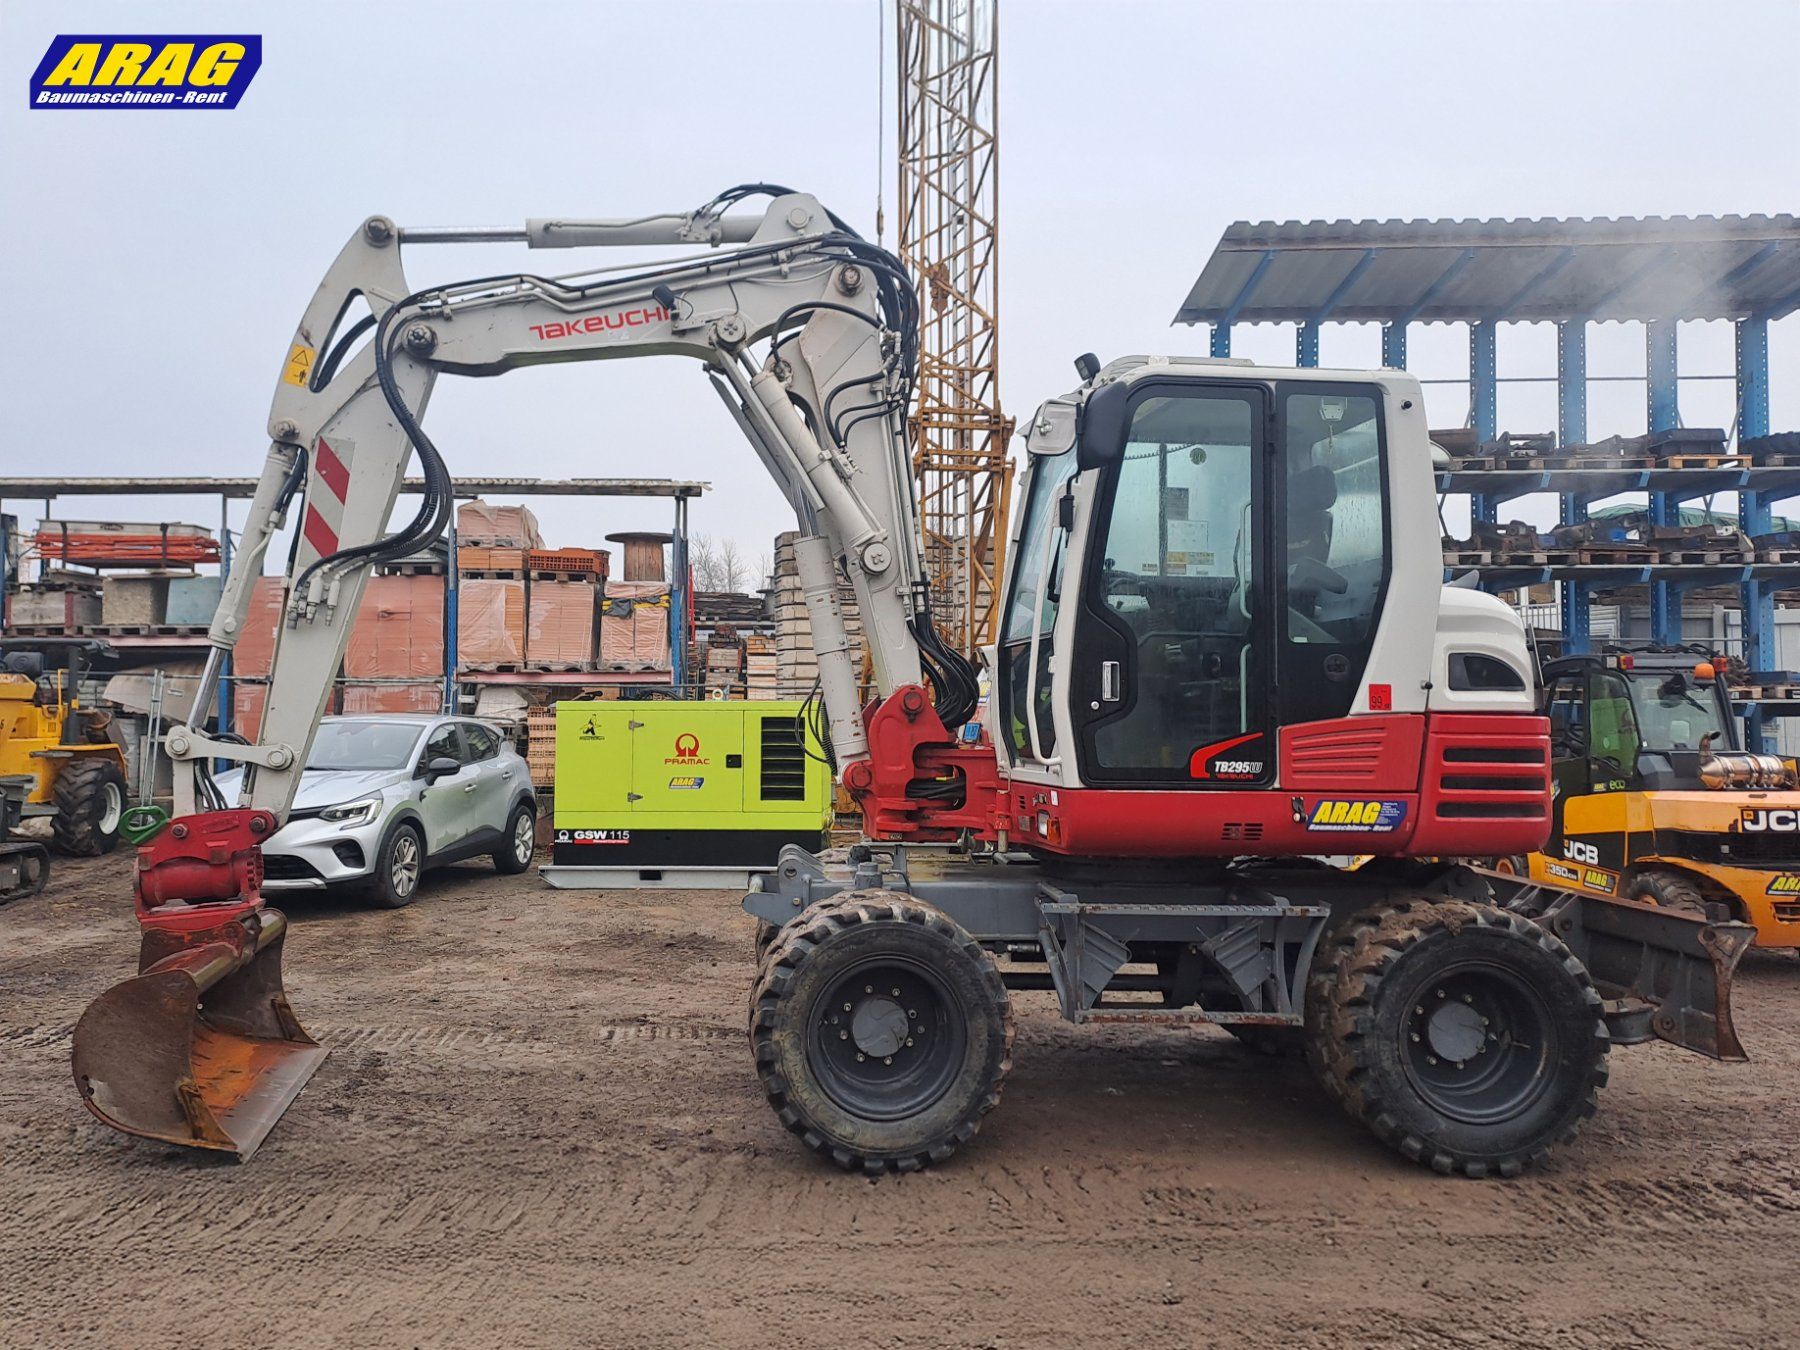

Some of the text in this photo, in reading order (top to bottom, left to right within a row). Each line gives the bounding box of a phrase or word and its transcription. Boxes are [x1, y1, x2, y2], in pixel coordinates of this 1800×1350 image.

[1215, 761, 1263, 773] TB295W
[1312, 801, 1381, 824] ARAG
[1743, 810, 1800, 831] JC
[574, 830, 630, 840] GSW 115
[1563, 839, 1599, 865] JCB
[1585, 870, 1608, 887] ARAG
[1771, 876, 1800, 890] AR
